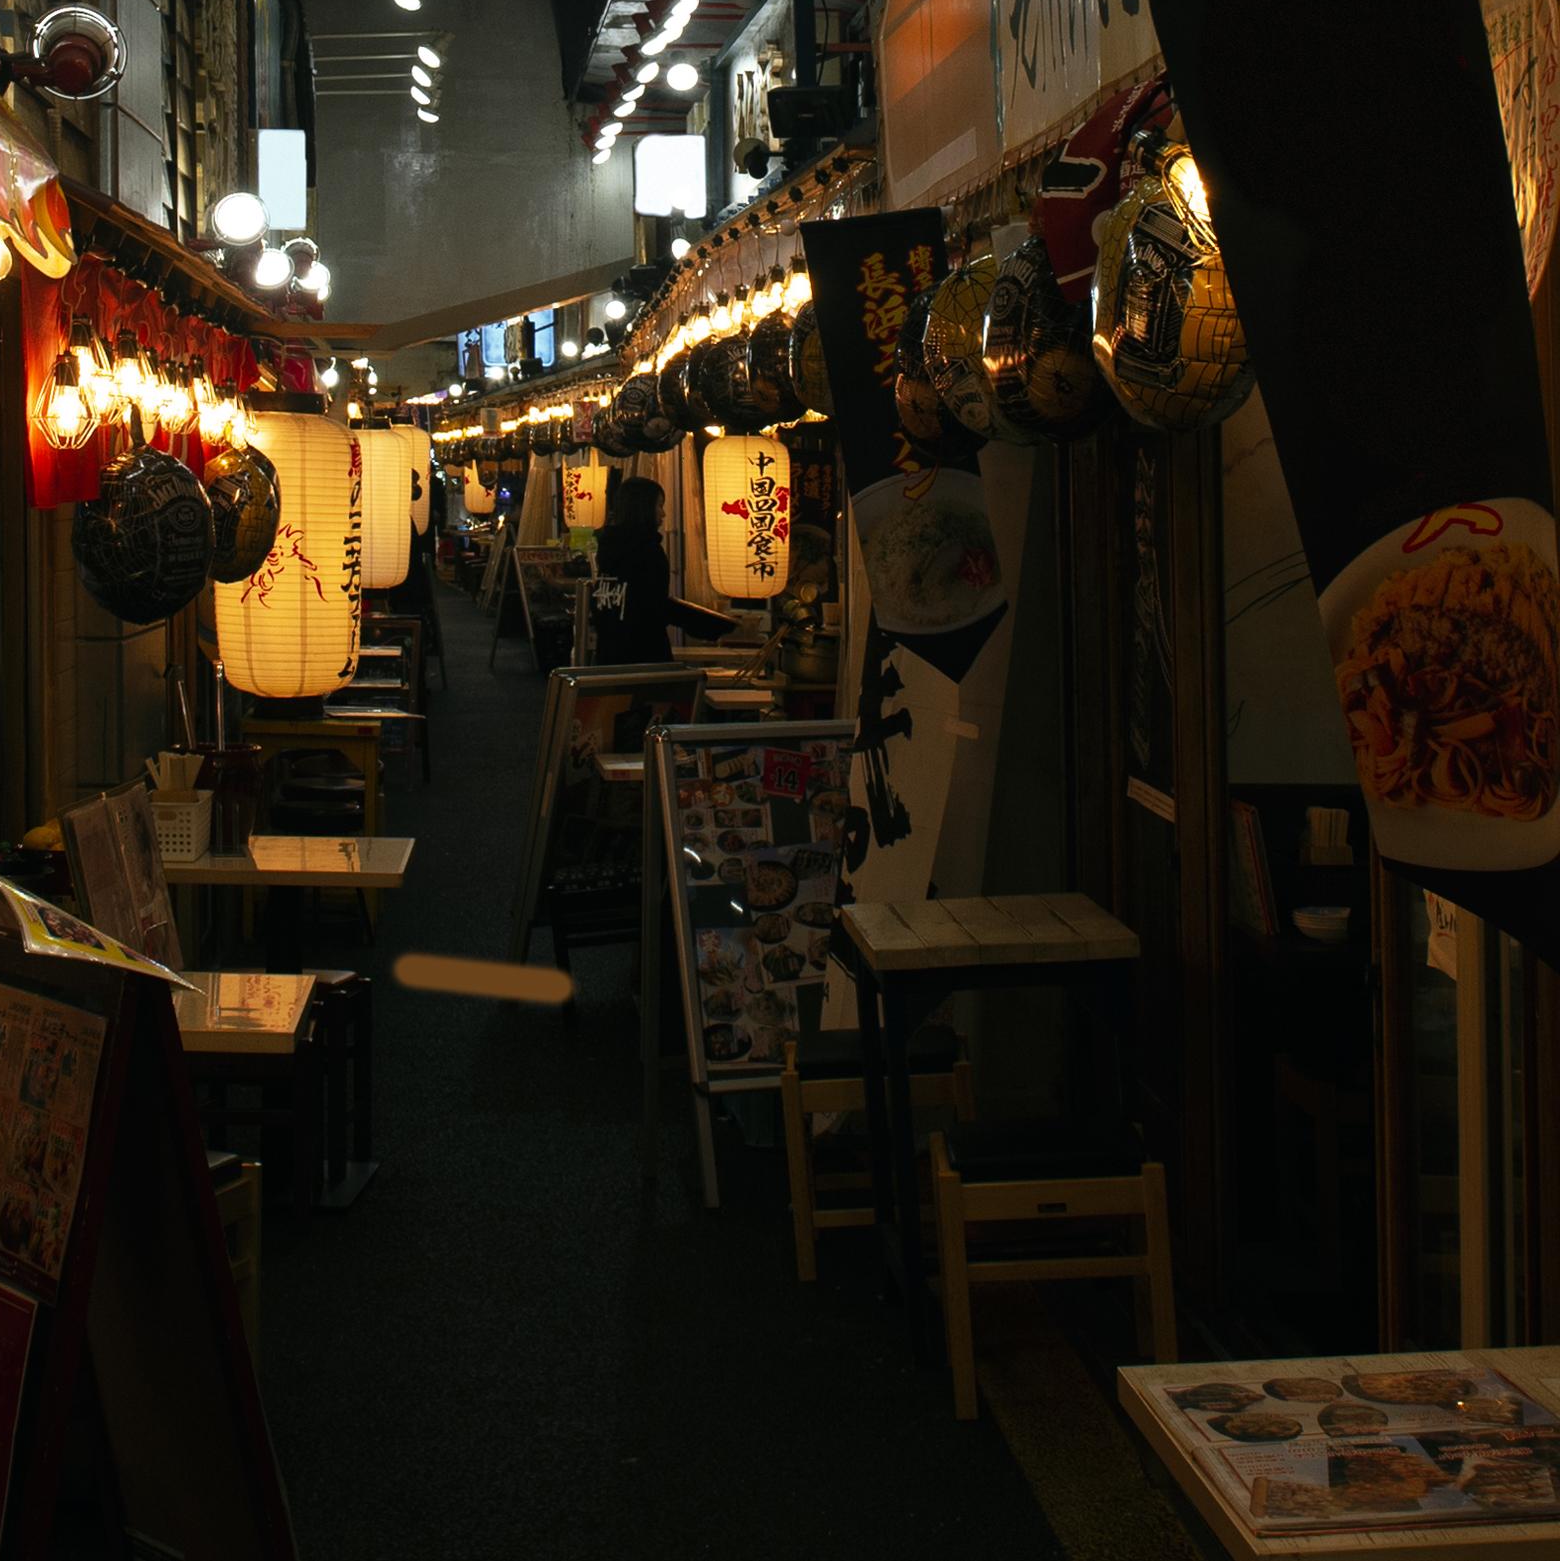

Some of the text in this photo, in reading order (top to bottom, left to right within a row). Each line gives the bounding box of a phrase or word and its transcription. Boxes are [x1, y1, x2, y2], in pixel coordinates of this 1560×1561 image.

[745, 450, 779, 583] 中国四国食市
